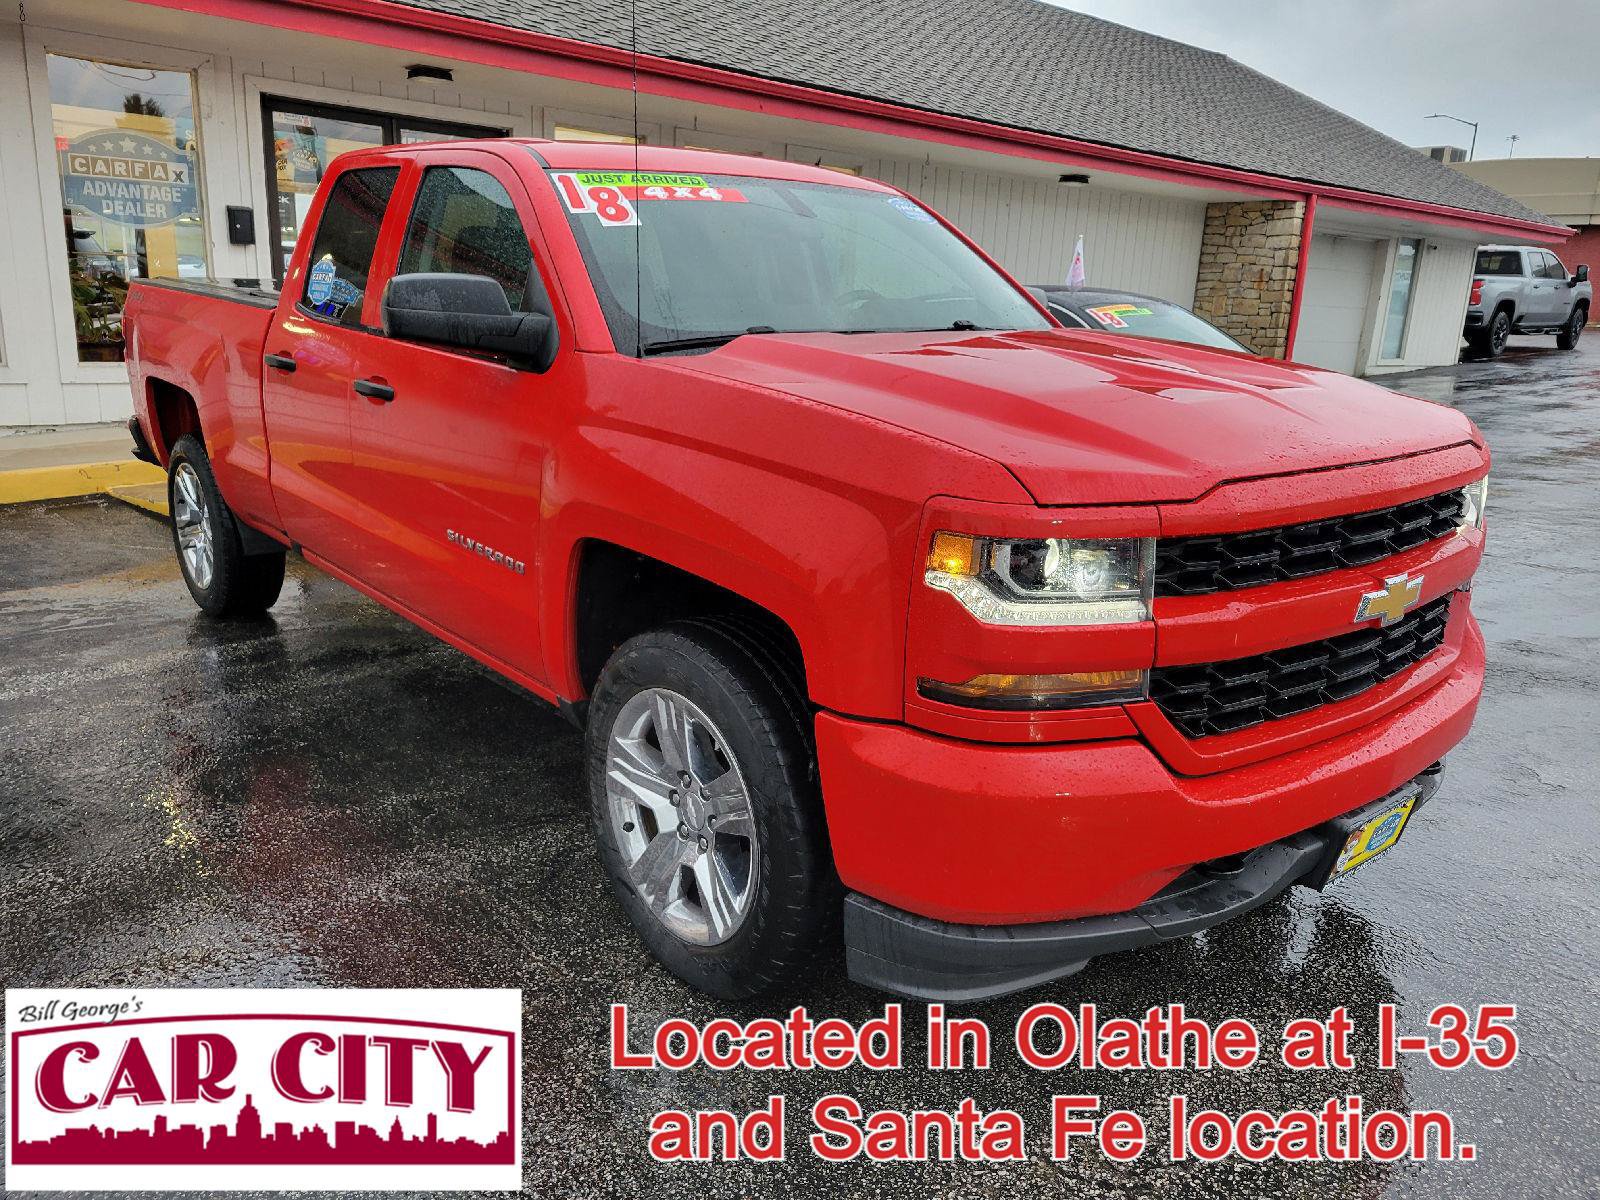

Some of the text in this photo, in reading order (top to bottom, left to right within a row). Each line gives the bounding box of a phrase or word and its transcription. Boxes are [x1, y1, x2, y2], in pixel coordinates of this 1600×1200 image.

[74, 157, 184, 183] CARFAX
[582, 174, 702, 186] JUST ARRIVED
[83, 180, 182, 203] ADVANTAGE
[102, 199, 168, 219] DEALER
[446, 528, 525, 576] SILVERADO
